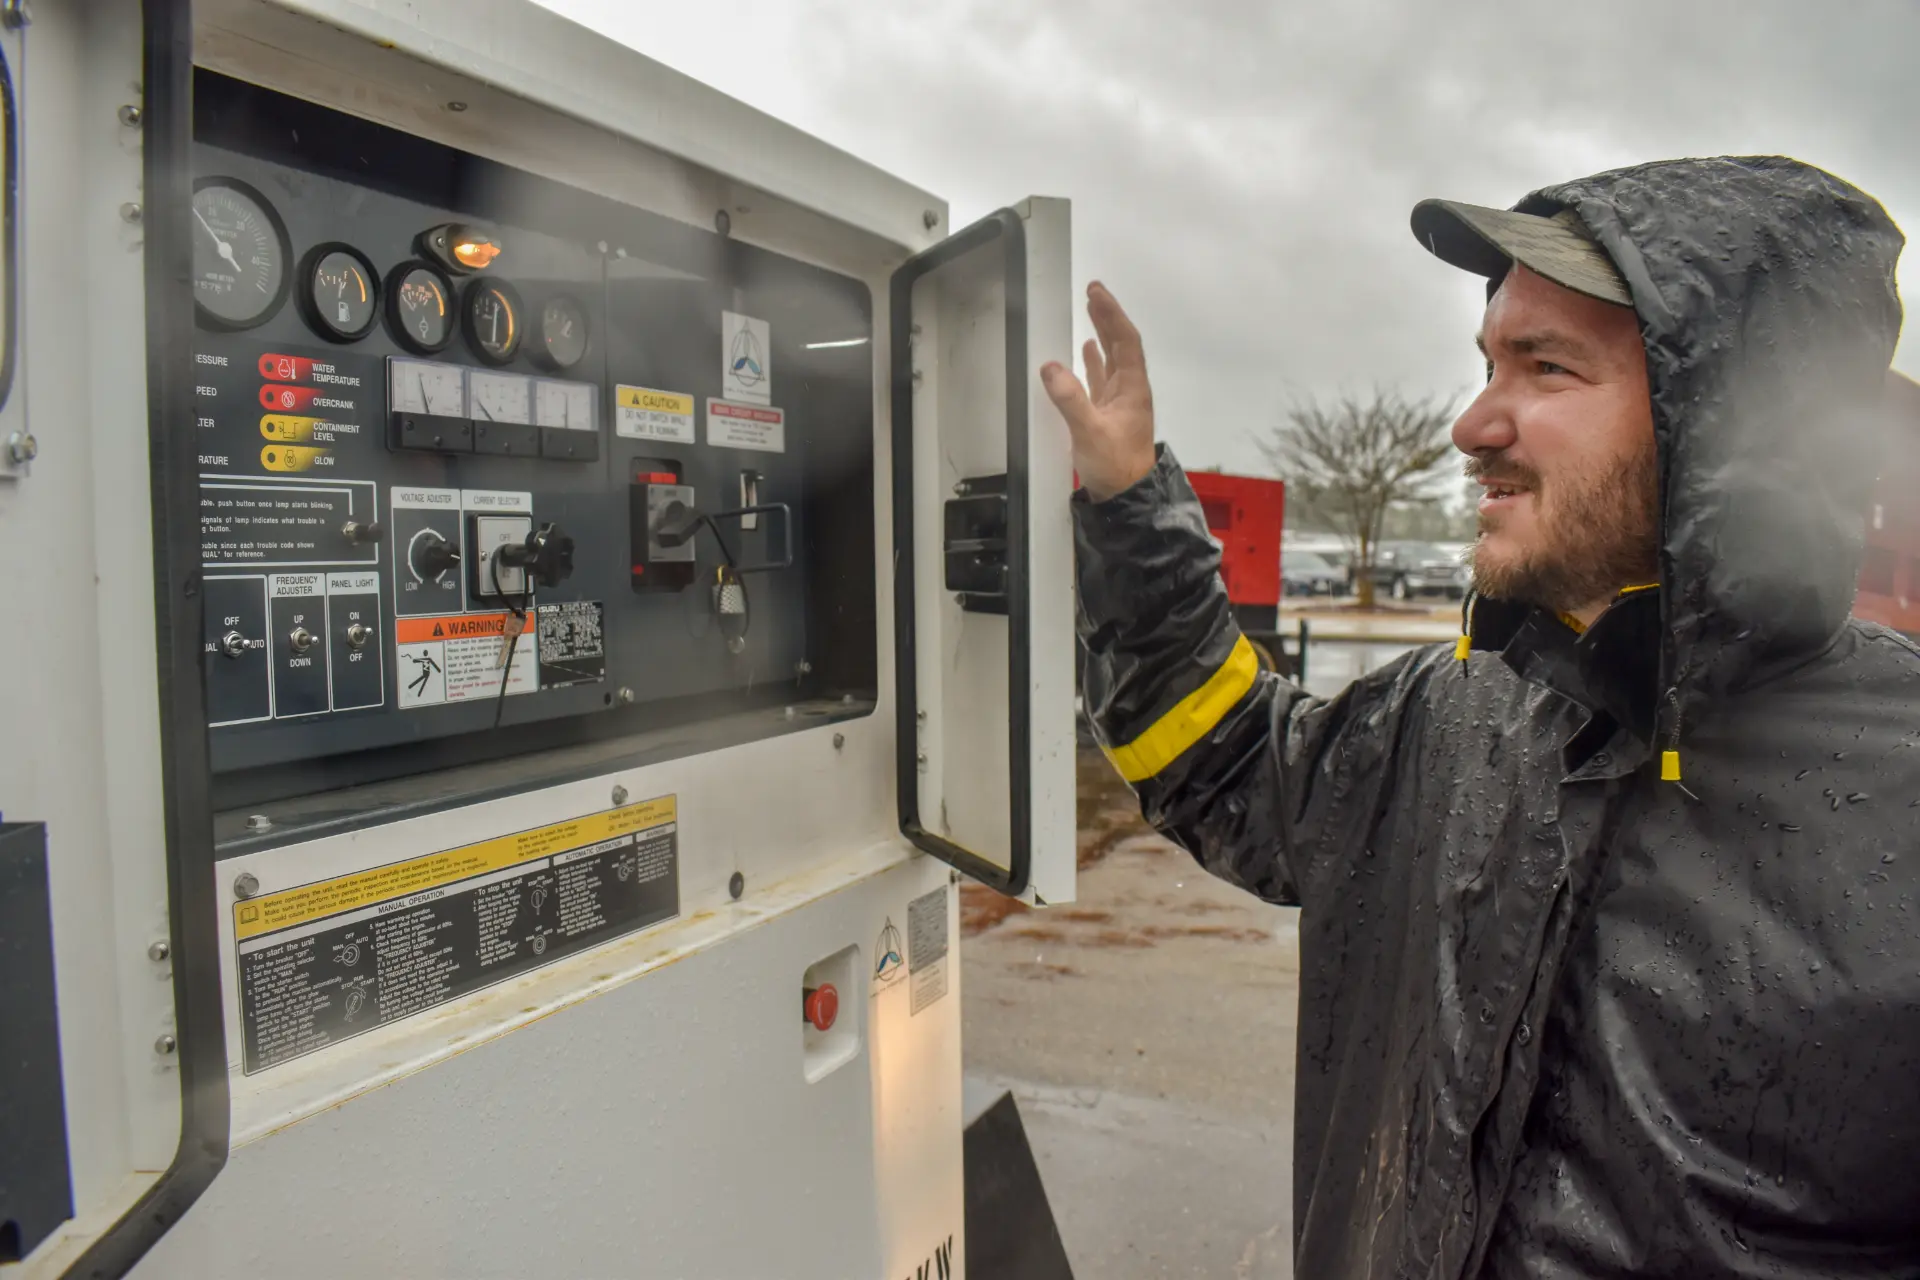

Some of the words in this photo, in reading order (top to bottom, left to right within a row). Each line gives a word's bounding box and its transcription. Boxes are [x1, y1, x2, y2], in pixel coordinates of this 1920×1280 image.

[312, 363, 335, 374] WATER
[312, 373, 360, 387] TEMPERATURE
[313, 397, 354, 409] OVERCRANK
[642, 394, 680, 410] CAUTION
[197, 417, 215, 428] TER
[313, 422, 360, 433] CONTAINMENT
[313, 432, 335, 442] LEVEL
[314, 457, 335, 466] GLOW
[218, 500, 233, 508] push
[400, 493, 425, 503] VOLTAGE
[426, 494, 452, 504] ADJUSTER
[473, 495, 496, 505] CURRENT
[497, 496, 521, 505] SELECTOR
[276, 575, 318, 585] FREQUENCY
[331, 579, 352, 588] PANEL
[355, 579, 374, 587] LIGHT
[442, 580, 456, 589] HIGH
[276, 586, 313, 595] ADJUSTER
[405, 581, 418, 591] LOW
[224, 616, 240, 626] OFF
[294, 614, 304, 624] UP
[349, 611, 360, 620] ON
[448, 619, 506, 635] WARNING
[205, 642, 219, 652] AL
[289, 657, 311, 668] DOWN
[349, 653, 363, 662] OFF
[565, 848, 593, 860] AUTOMATIC
[595, 840, 622, 852] OPERATION
[264, 900, 283, 908] Before
[284, 892, 310, 903] operating
[359, 874, 378, 884] manual
[411, 862, 429, 871] operate
[308, 896, 329, 906] perform
[341, 887, 361, 897] periodic
[363, 881, 389, 891] inspection
[400, 870, 429, 880] maintenance
[478, 888, 486, 896] To
[487, 885, 500, 893] stop
[512, 877, 523, 886] unit
[271, 914, 287, 923] could
[338, 896, 359, 905] damage
[375, 886, 395, 896] periodic
[397, 879, 421, 889] inspection
[378, 901, 406, 914] MANUAL
[408, 889, 445, 905] OPERATION
[381, 924, 397, 933] no-load
[398, 920, 410, 928] about
[345, 932, 354, 940] OFF
[376, 940, 389, 948] Check
[390, 934, 411, 944] frequency
[417, 926, 436, 937] generator
[387, 930, 403, 938] starting
[356, 936, 369, 944] AUTO
[253, 953, 264, 961] To
[266, 946, 284, 958] start
[286, 943, 298, 952] the
[301, 937, 315, 947] unit
[376, 947, 390, 955] adjust
[390, 941, 411, 951] frequency
[384, 946, 412, 959] "FREQUENCY
[413, 938, 436, 950] ADJUSTER"
[275, 955, 294, 965] breaker
[253, 971, 262, 979] Set
[273, 962, 296, 975] operating
[297, 956, 315, 966] selector
[385, 966, 412, 979] "FREQUENCY
[277, 978, 293, 986] starter
[294, 972, 310, 981] switch
[360, 977, 375, 986] START
[288, 980, 308, 991] position
[341, 981, 354, 990] STOP
[379, 993, 393, 1002] Adjust
